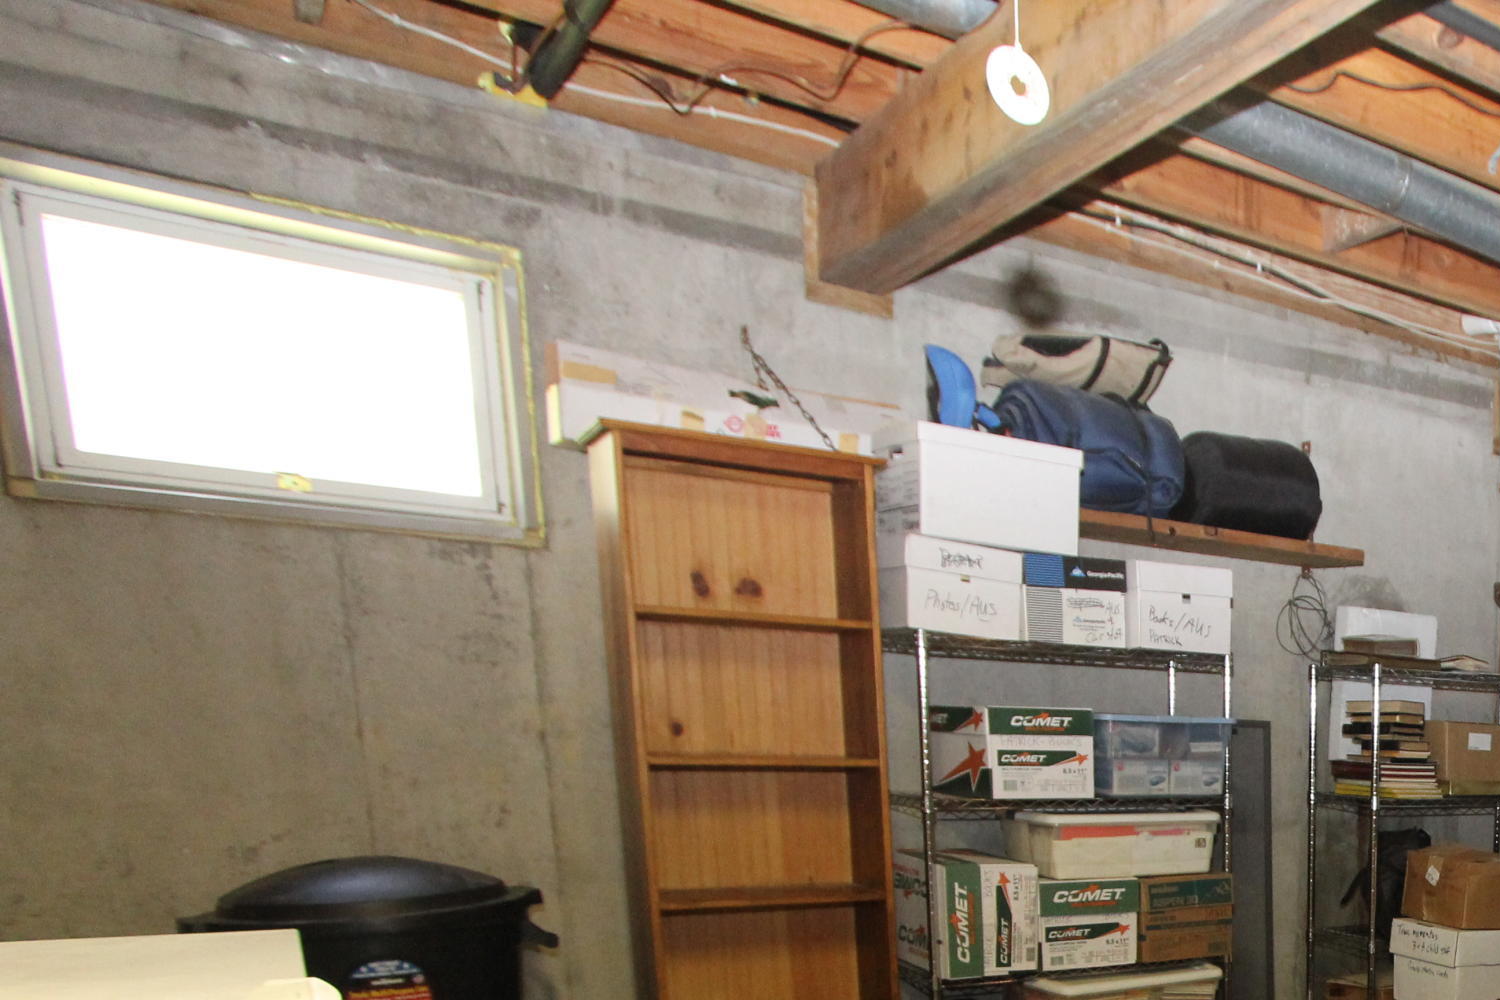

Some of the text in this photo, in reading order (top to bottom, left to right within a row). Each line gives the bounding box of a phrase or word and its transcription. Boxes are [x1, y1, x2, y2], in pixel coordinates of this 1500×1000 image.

[1010, 715, 1073, 728] COMET
[1000, 754, 1047, 763] COMET
[1053, 887, 1127, 904] COMET
[954, 882, 971, 964] COMET
[1048, 928, 1092, 939] COMET
[999, 918, 1009, 965] COMET
